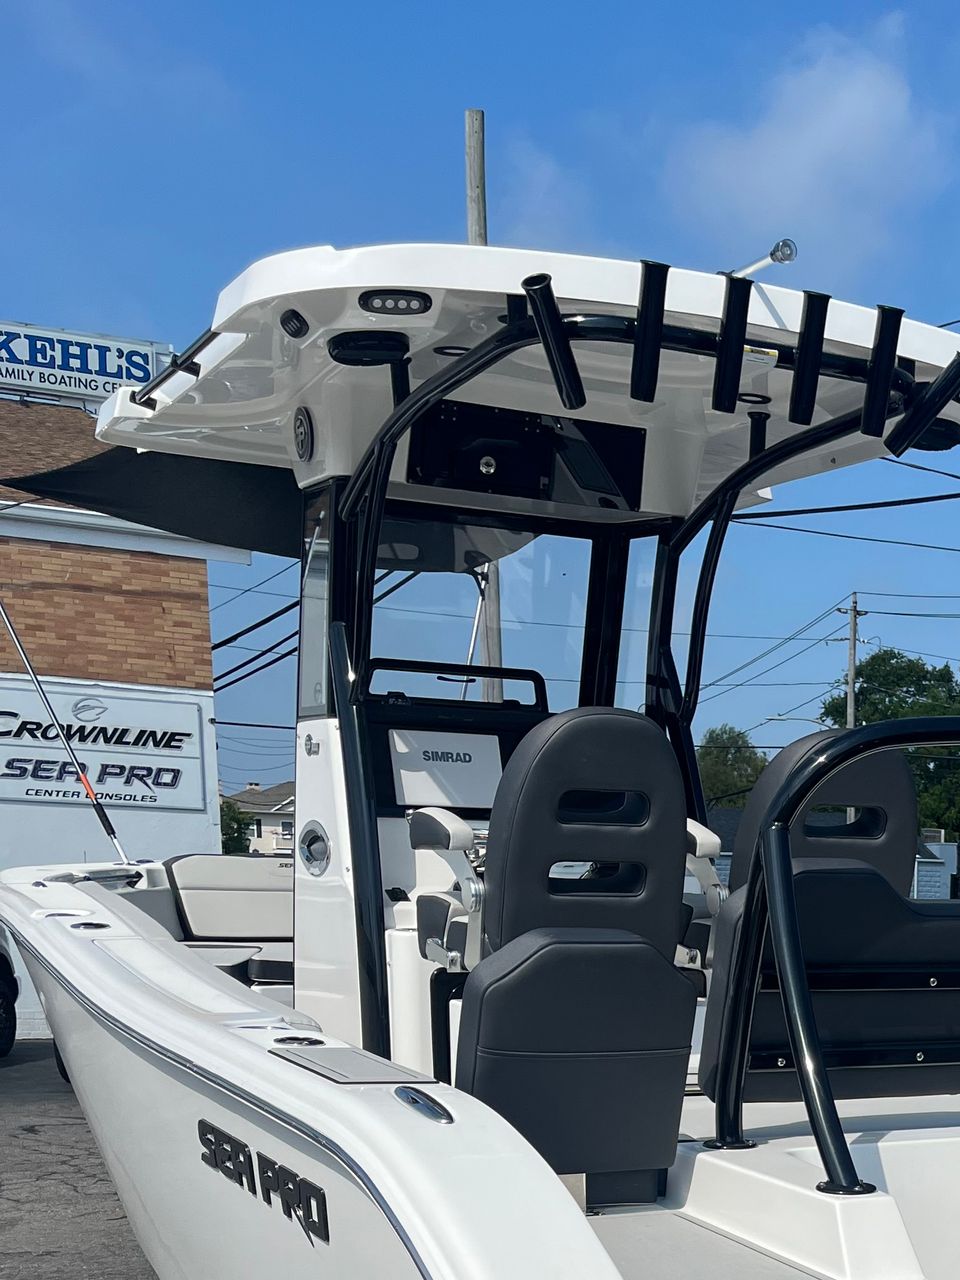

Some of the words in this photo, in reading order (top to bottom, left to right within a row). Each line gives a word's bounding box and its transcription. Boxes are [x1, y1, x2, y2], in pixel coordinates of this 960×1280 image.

[0, 331, 151, 384] KEHL'S
[39, 371, 99, 391] BOATING
[0, 711, 193, 750] CROWNLINE
[0, 757, 88, 783] SEA
[96, 763, 182, 794] PRO
[422, 750, 472, 764] SIMRAD
[25, 788, 81, 799] CENTER
[198, 1119, 257, 1198] SEA
[257, 1151, 329, 1248] PRO
